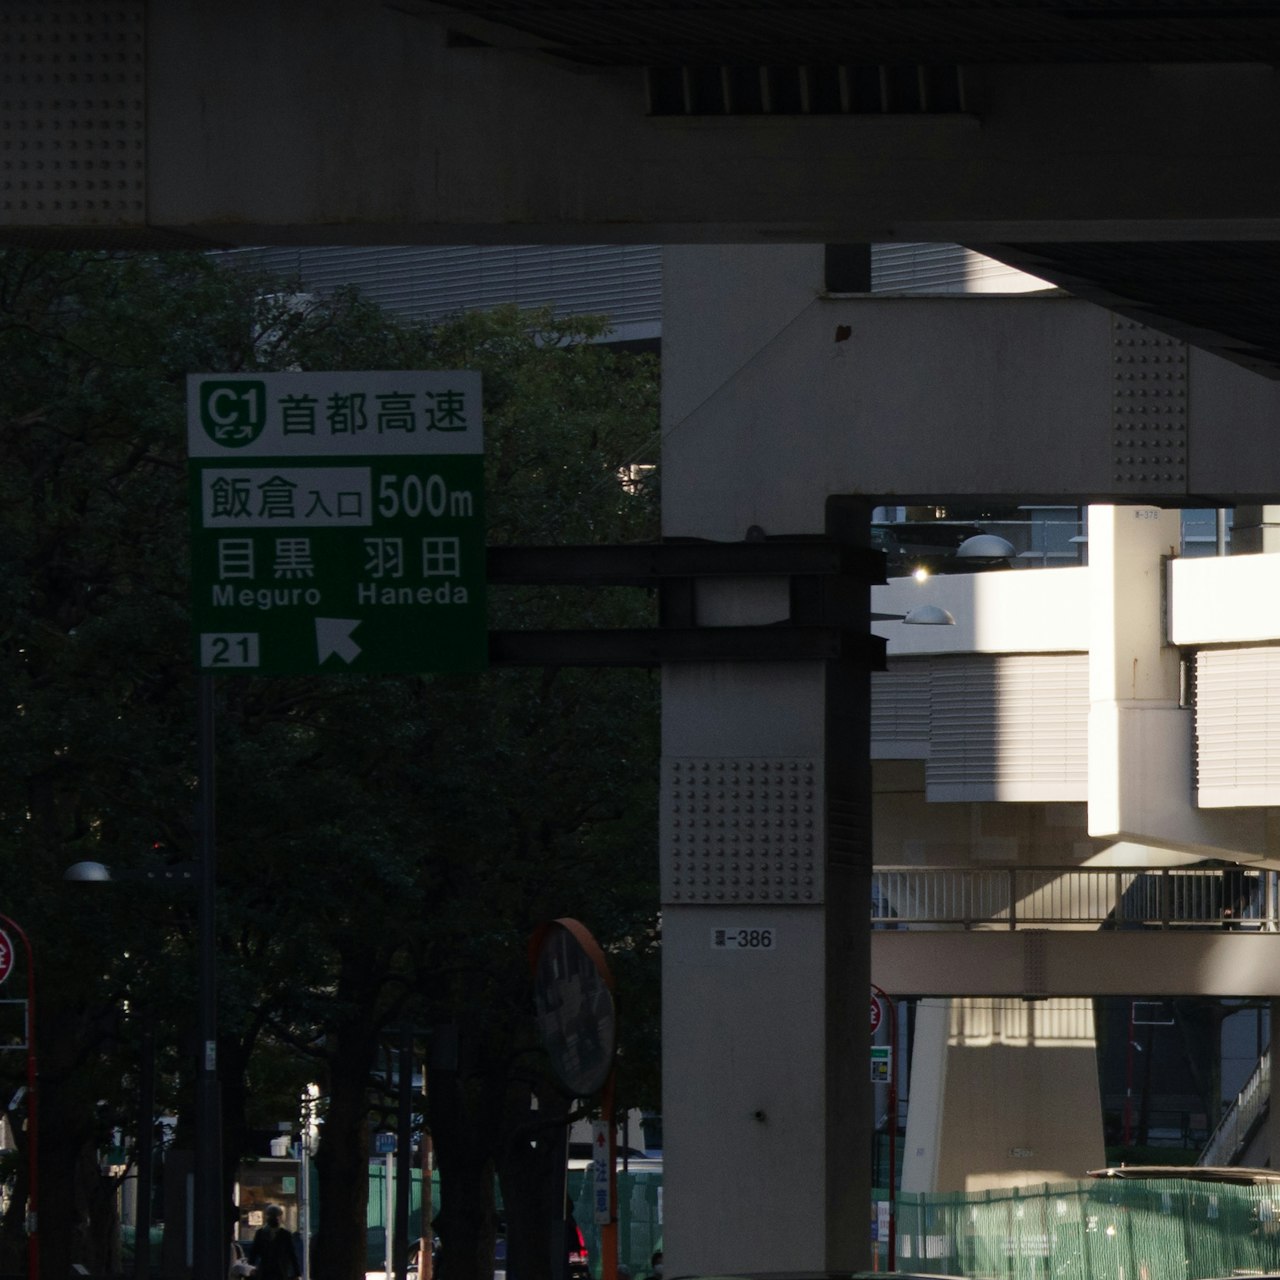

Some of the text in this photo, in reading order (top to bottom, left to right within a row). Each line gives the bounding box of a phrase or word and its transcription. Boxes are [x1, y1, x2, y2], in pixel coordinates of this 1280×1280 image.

[207, 388, 257, 424] C1
[278, 391, 467, 436] 首都高速
[210, 475, 363, 520] 飯倉入口
[378, 474, 473, 518] 500m
[218, 537, 315, 580] 目黒
[363, 536, 461, 578] 羽田
[212, 584, 321, 609] Meguro
[358, 582, 469, 605] Haneda
[211, 636, 250, 663] 21
[596, 1159, 608, 1213] 注意
